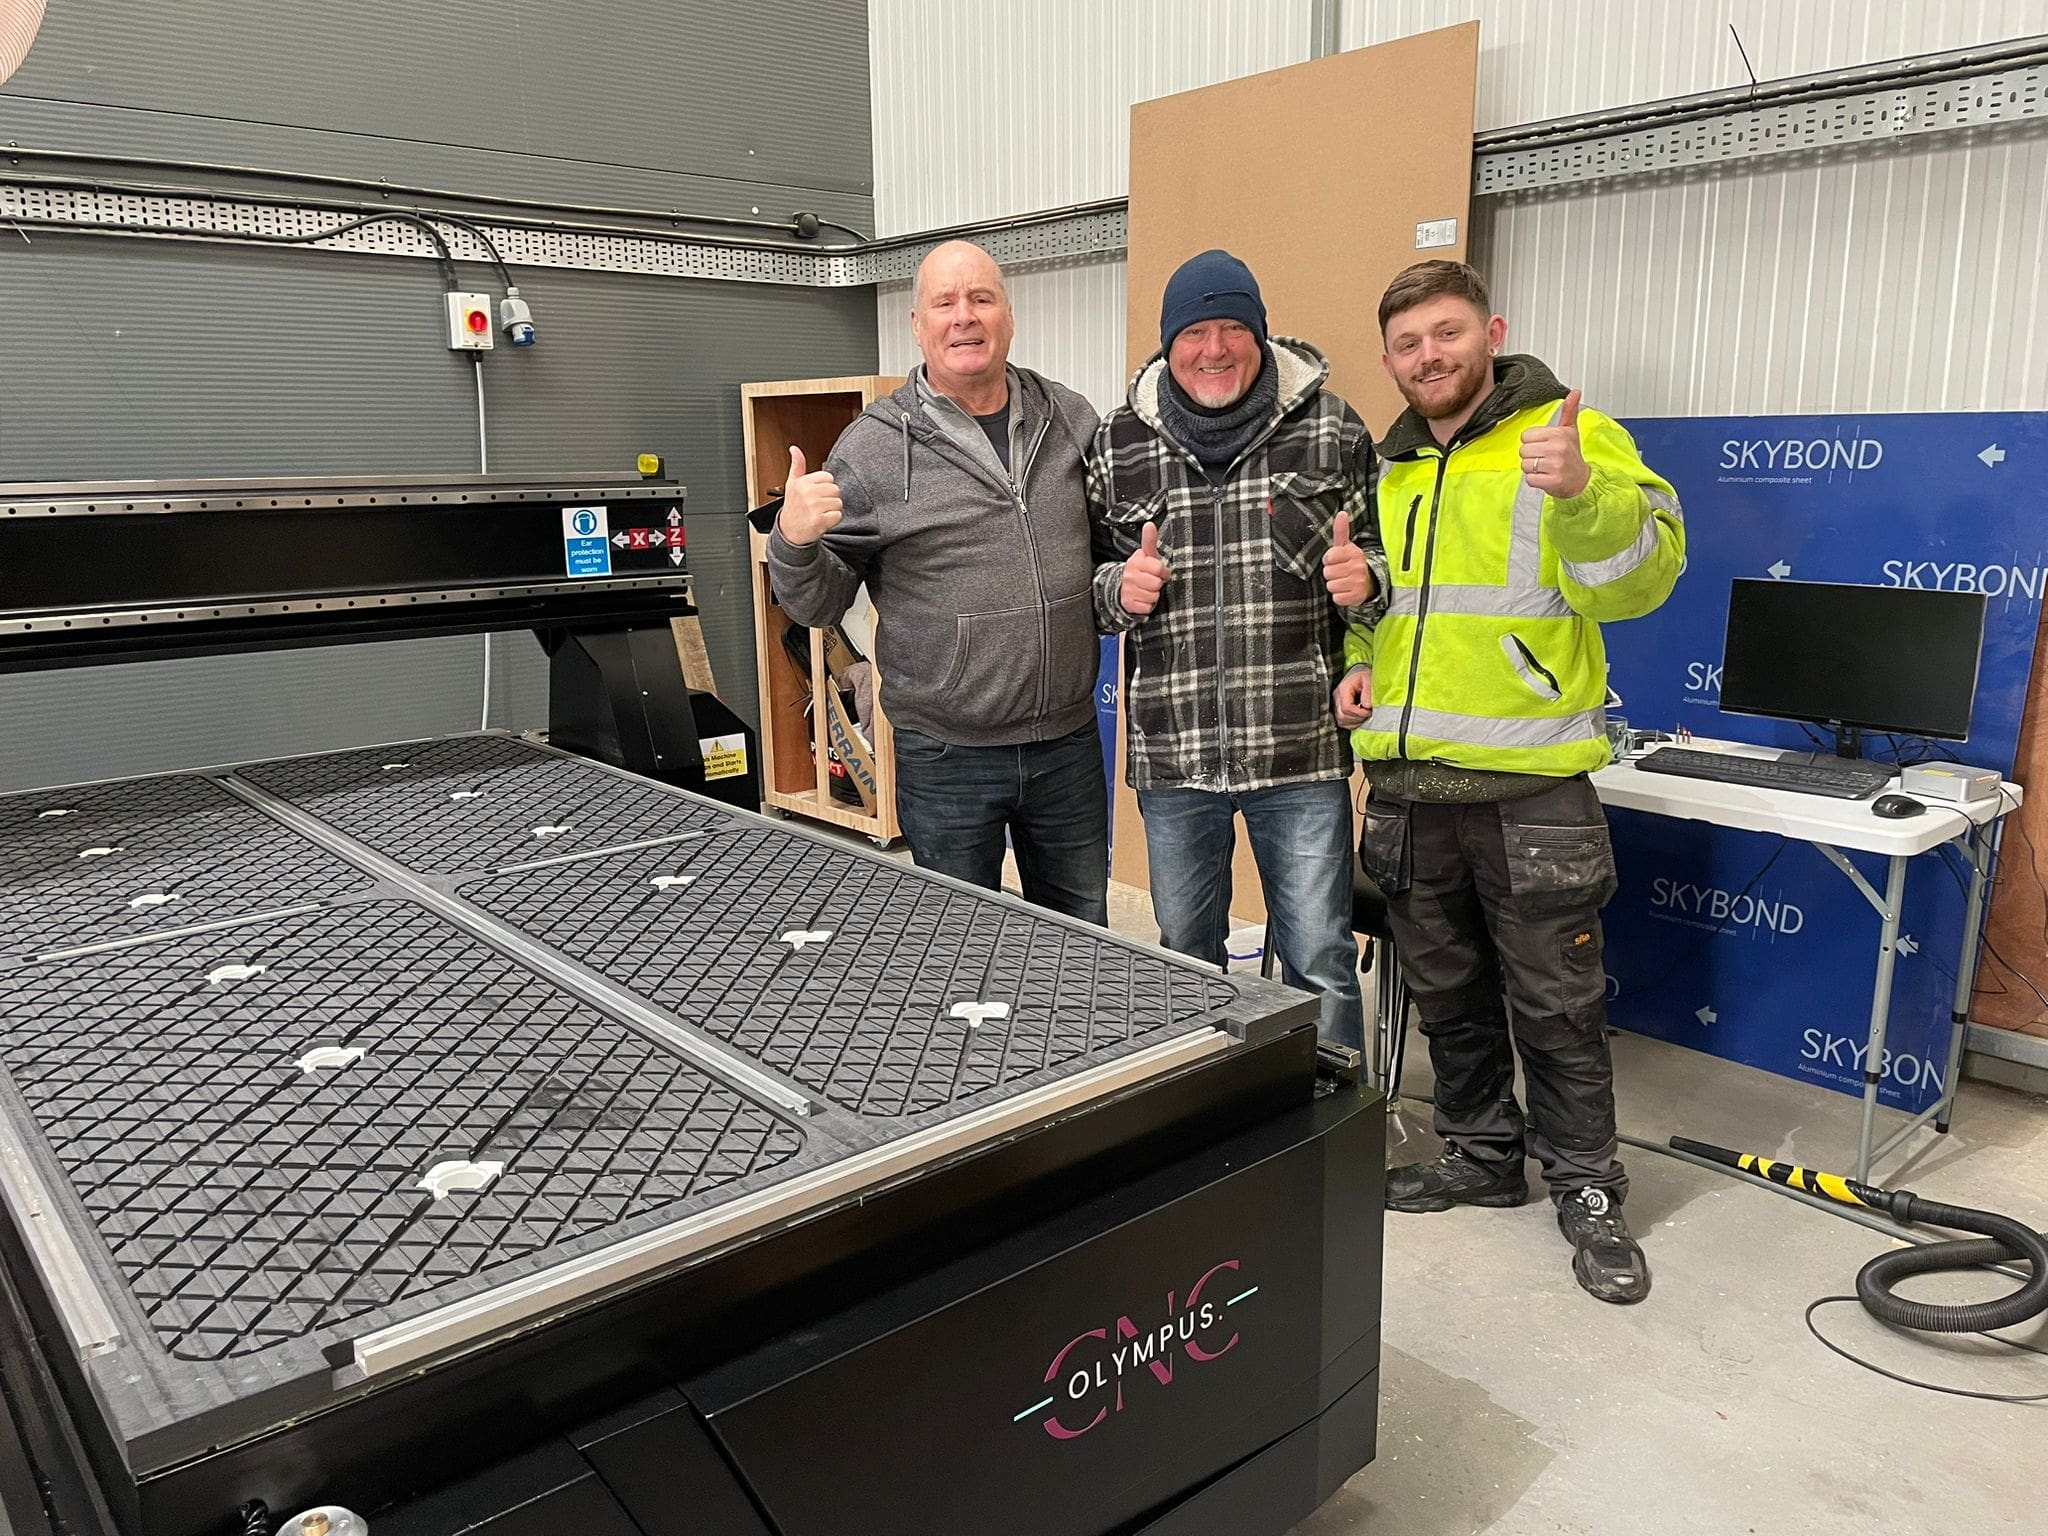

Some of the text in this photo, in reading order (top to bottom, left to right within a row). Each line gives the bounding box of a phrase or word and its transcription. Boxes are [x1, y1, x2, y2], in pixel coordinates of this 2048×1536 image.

[1720, 439, 1883, 470] SKYBOND
[1717, 476, 1812, 486] Aluminium composite sheet
[633, 532, 646, 546] X
[571, 548, 604, 558] protection
[1880, 559, 2048, 600] SKYBON
[1683, 696, 1720, 706] Aluminium
[711, 752, 737, 761] Machine
[725, 759, 742, 767] Starts
[1650, 877, 1804, 934] SKYBOND
[1800, 1027, 1947, 1094] SKYBON
[1797, 1062, 1838, 1080] Aluminium
[1838, 1075, 1864, 1088] compo
